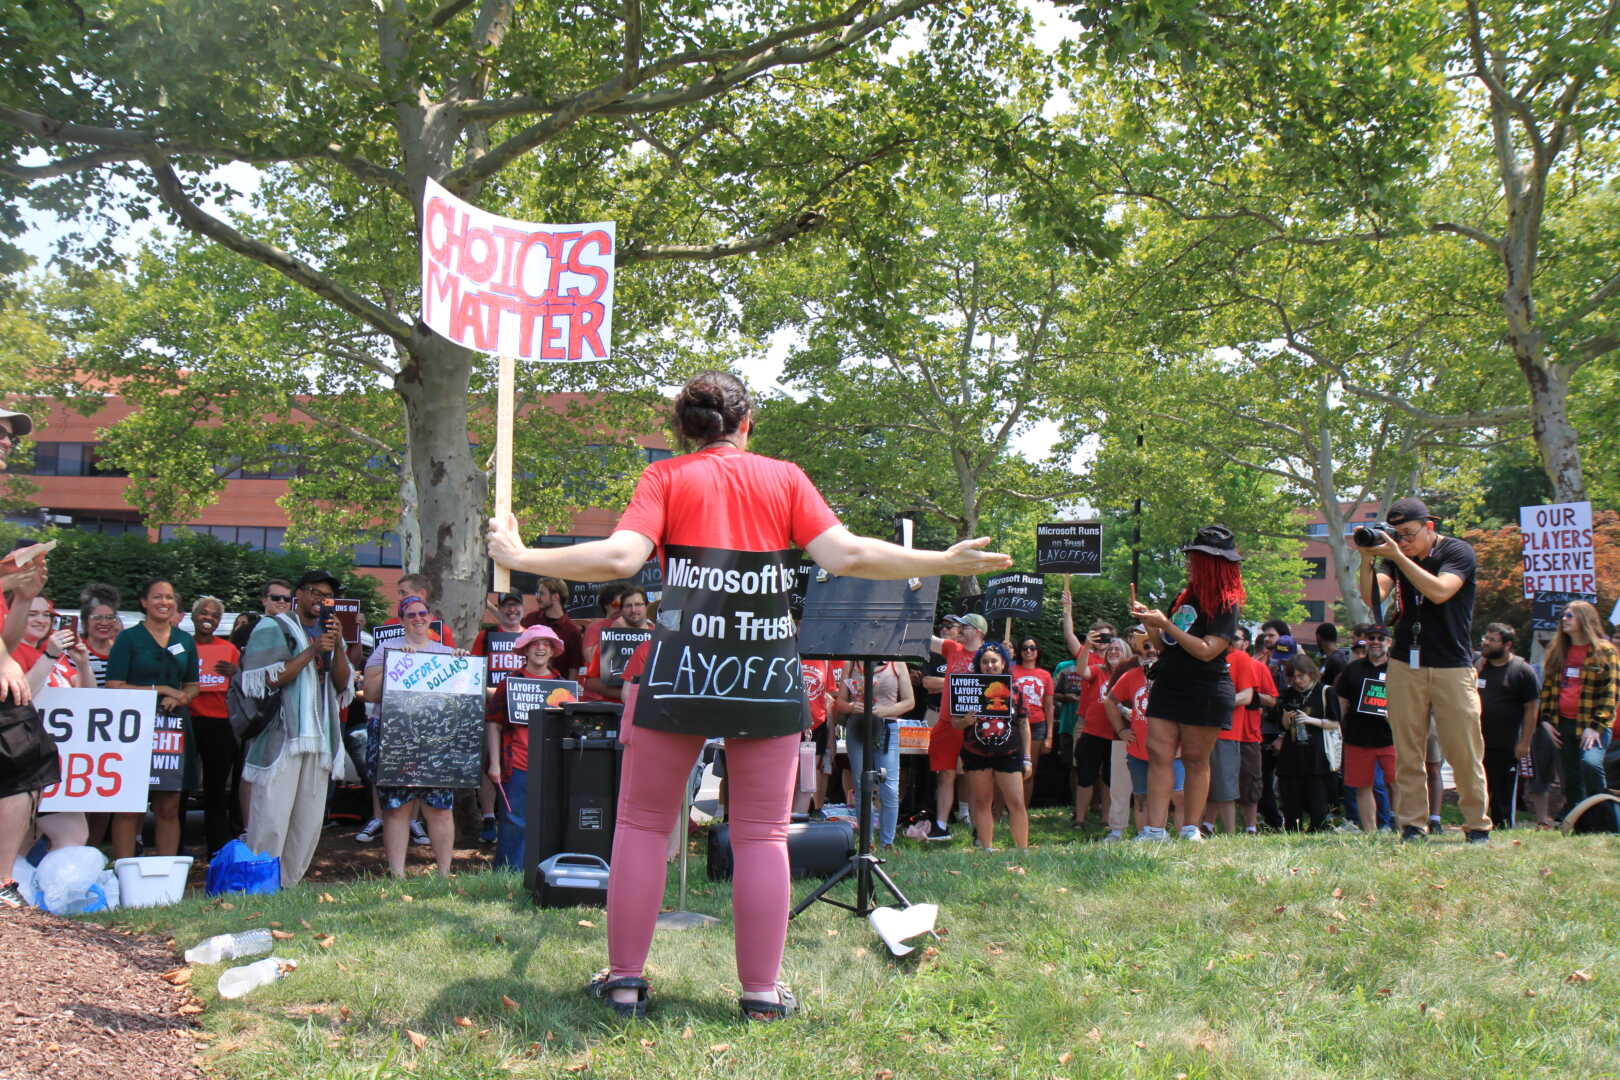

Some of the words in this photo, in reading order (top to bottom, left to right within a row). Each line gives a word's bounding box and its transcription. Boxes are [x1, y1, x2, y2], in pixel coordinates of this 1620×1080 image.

[426, 197, 612, 305] CHOICES
[427, 258, 608, 360] MATTER
[1536, 508, 1576, 528] OUR
[1038, 526, 1076, 536] Microsoft
[1078, 526, 1100, 536] Runs
[1521, 529, 1593, 551] PLAYERS
[1523, 551, 1593, 572] DESERVE
[667, 556, 778, 595] Microsoft
[988, 574, 1020, 588] Microsoft
[1022, 574, 1044, 585] Runs
[1525, 574, 1597, 593] BETTER
[691, 613, 726, 640] on
[734, 609, 793, 641] Trust
[376, 628, 405, 639] LAYOFFS
[601, 631, 651, 642] Microsoft
[492, 641, 516, 652] WHEN
[621, 647, 634, 655] on
[388, 654, 413, 682] DEVS
[492, 654, 526, 668] FIGH
[402, 656, 441, 689] BEFORE
[427, 657, 469, 690] DOLLARS
[513, 692, 544, 703] LAYOFFS
[954, 687, 983, 695] LAYOFFS
[957, 696, 979, 704] NEVER
[955, 704, 982, 713] CHANGE
[87, 708, 141, 743] RO
[168, 716, 184, 729] WE
[153, 755, 179, 770] WIN
